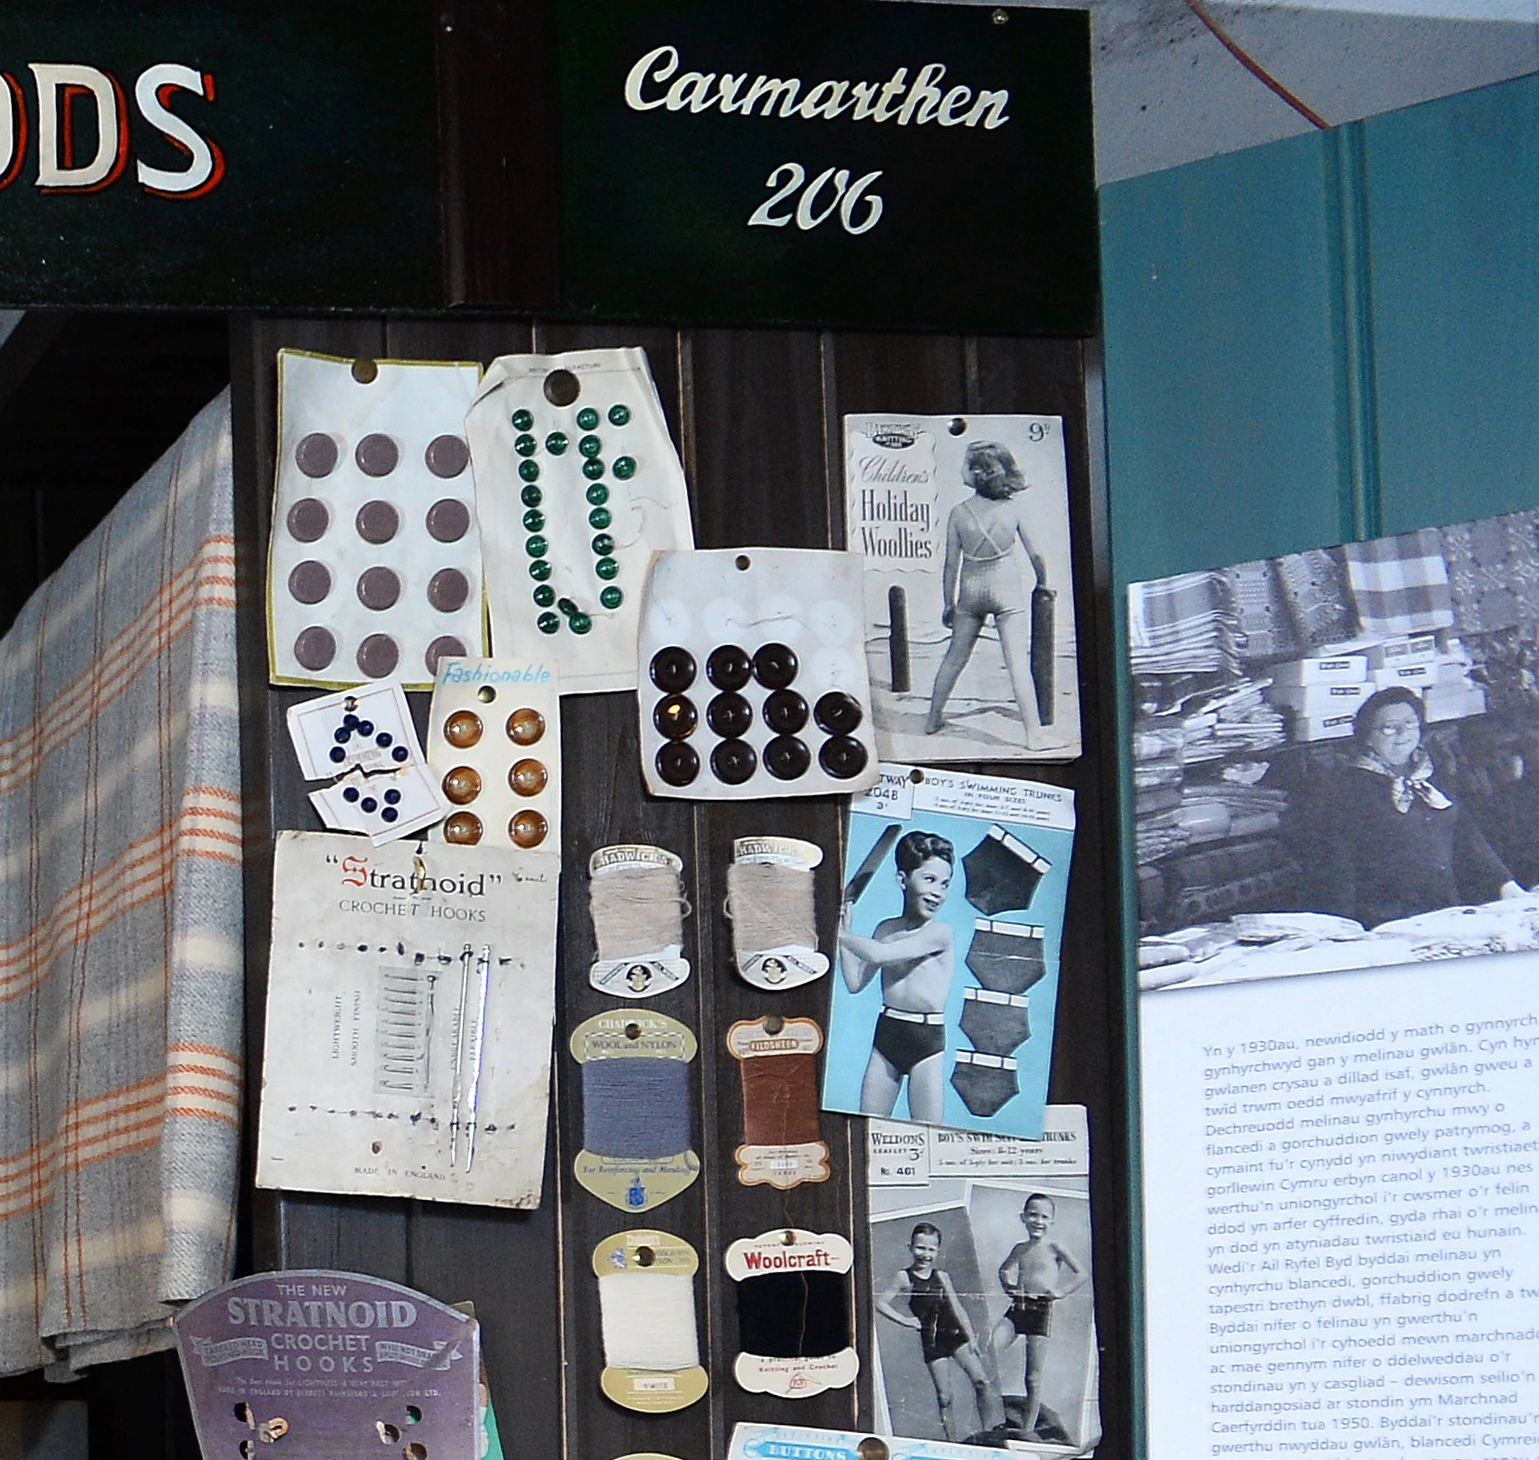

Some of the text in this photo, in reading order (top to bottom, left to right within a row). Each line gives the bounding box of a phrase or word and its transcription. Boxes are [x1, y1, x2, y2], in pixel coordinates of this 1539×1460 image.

[623, 45, 1010, 130] Carmarthen
[746, 162, 883, 235] 206
[859, 456, 930, 485] Children's
[861, 488, 930, 532] Holiday
[861, 527, 932, 559] Woollies
[441, 662, 551, 686] Fashionable
[959, 780, 1018, 796] SWIMMING
[1023, 788, 1063, 803] TRUNKS
[339, 899, 487, 923] CROCHET HOOKS
[592, 1040, 621, 1050] WOOL
[641, 1039, 677, 1050] NYLON
[1201, 1012, 1538, 1060] Yn y 1930au, newidiodd y math o gynnyrch
[1205, 1103, 1506, 1137] Dechreuodd melinau gynhyrchu mwy o
[871, 1132, 925, 1147] WELDONS
[1207, 1180, 1530, 1215] werthu'n uniongyrchol i'r cwsmer o'r felin
[743, 1248, 831, 1270] Woolcraft
[1207, 1247, 1502, 1275] Wedi'r Ail Ryfel Byd byddai melinau yn
[275, 1283, 348, 1297] THE NEW
[227, 1296, 418, 1329] STRATNOID
[270, 1332, 371, 1352] CROCHET
[273, 1354, 373, 1374] HOOKS
[1210, 1389, 1518, 1416] harddangosiad ar stondin ym Marchnad
